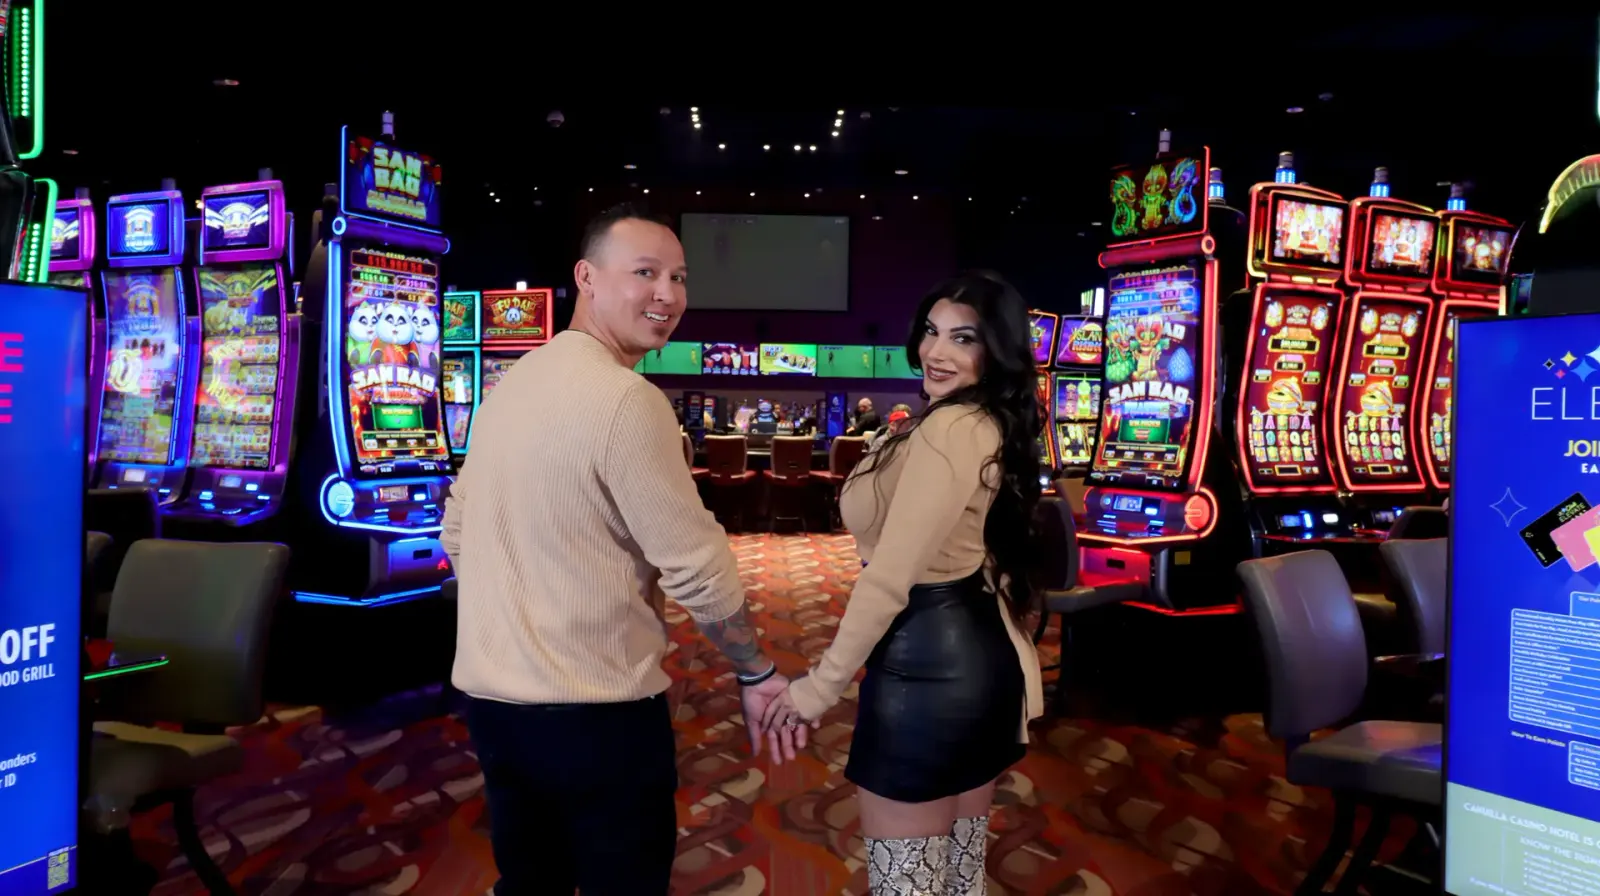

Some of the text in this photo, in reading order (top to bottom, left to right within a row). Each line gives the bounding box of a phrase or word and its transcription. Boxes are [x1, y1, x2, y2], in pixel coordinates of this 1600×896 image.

[373, 147, 421, 178] SAN
[353, 366, 394, 391] SAN
[1108, 380, 1146, 404] SAN
[0, 623, 55, 665] OFF
[0, 663, 56, 687] OD GRILL
[0, 752, 37, 771] onders
[4, 773, 16, 787] ID
[1509, 815, 1548, 832] CASINO
[1549, 826, 1581, 843] HOTEL
[1520, 836, 1551, 851] KNOW
[1553, 846, 1572, 859] THE
